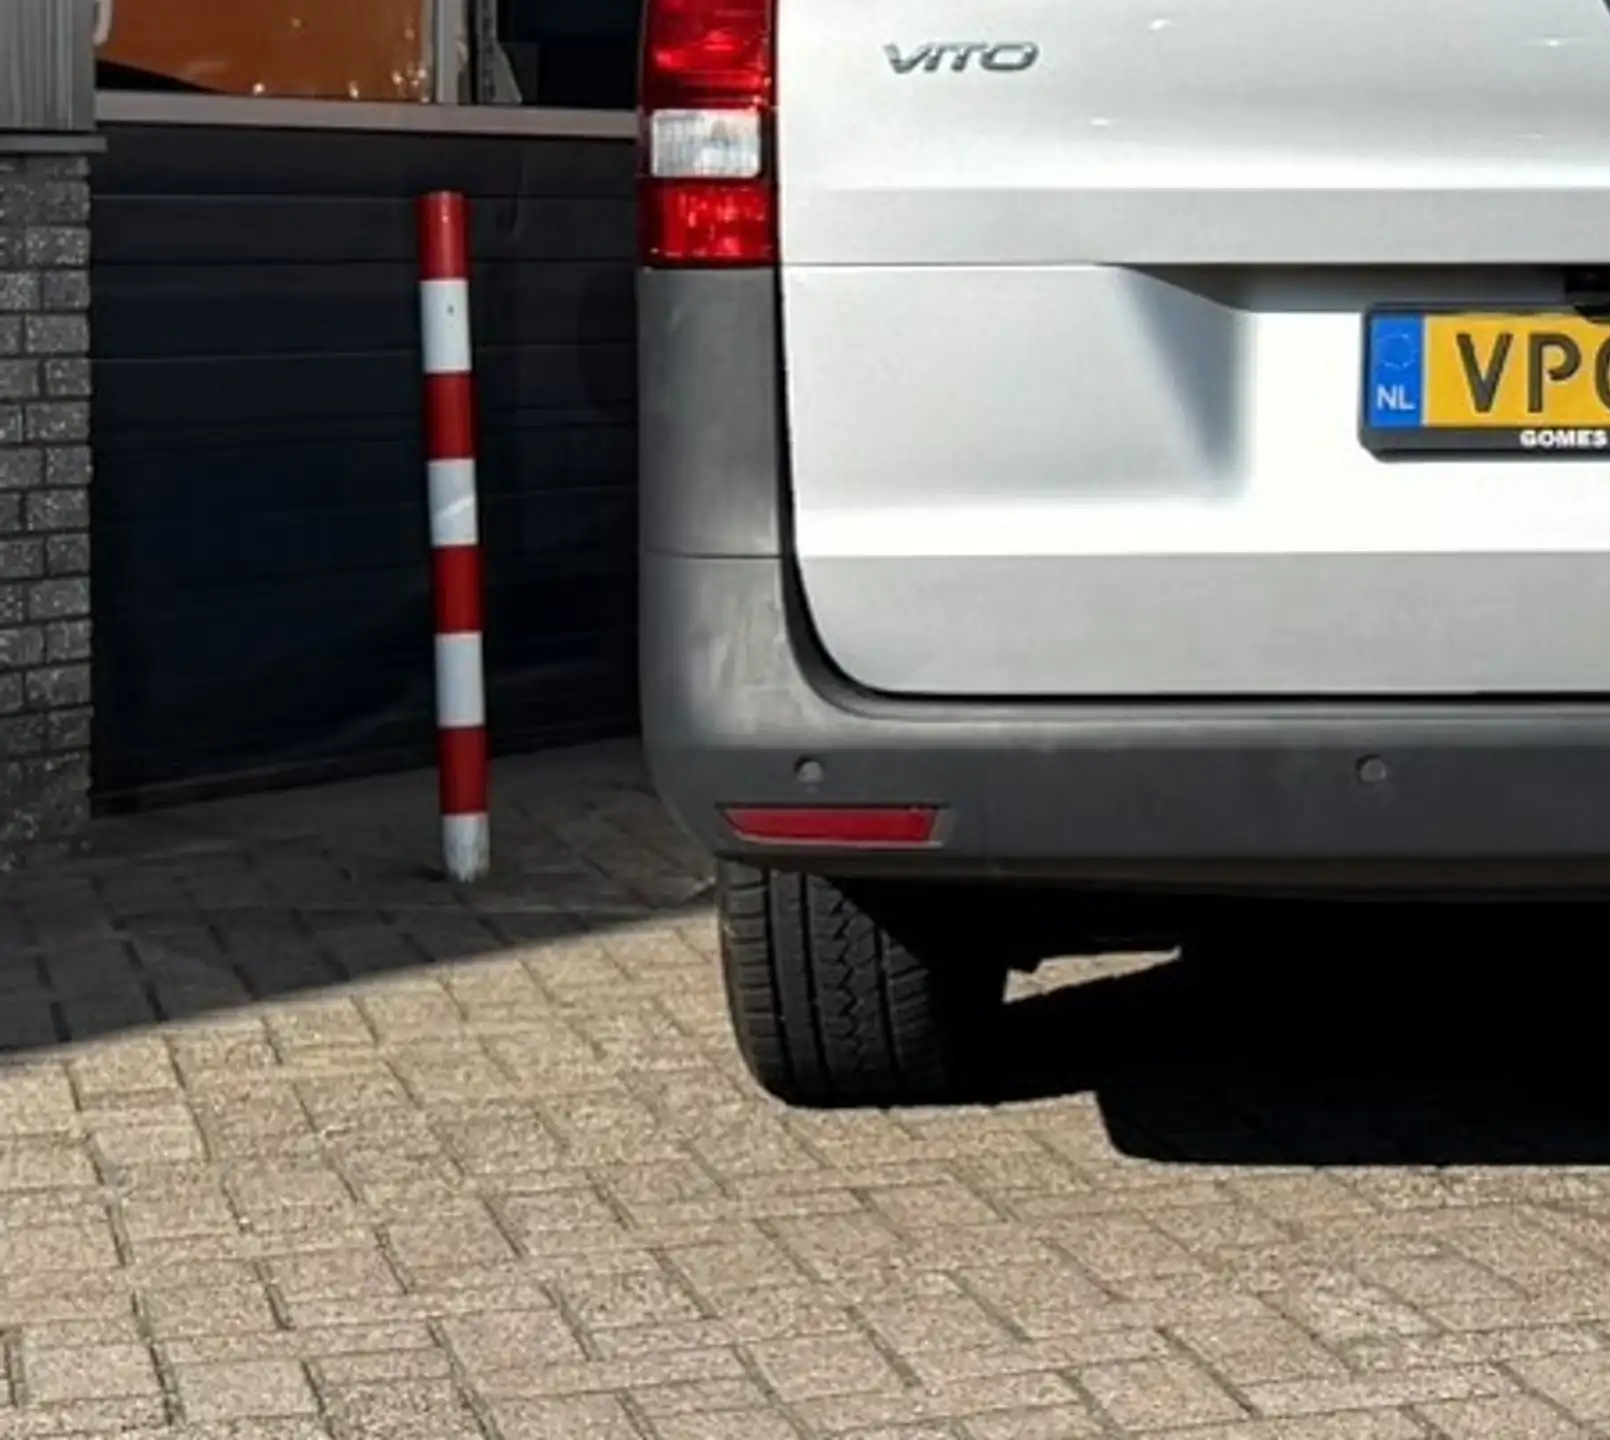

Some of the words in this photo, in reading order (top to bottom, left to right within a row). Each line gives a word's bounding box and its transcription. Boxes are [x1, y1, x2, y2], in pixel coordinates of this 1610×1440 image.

[882, 41, 1040, 75] VITO
[1377, 383, 1417, 411] NL
[1519, 428, 1608, 448] GOMES
